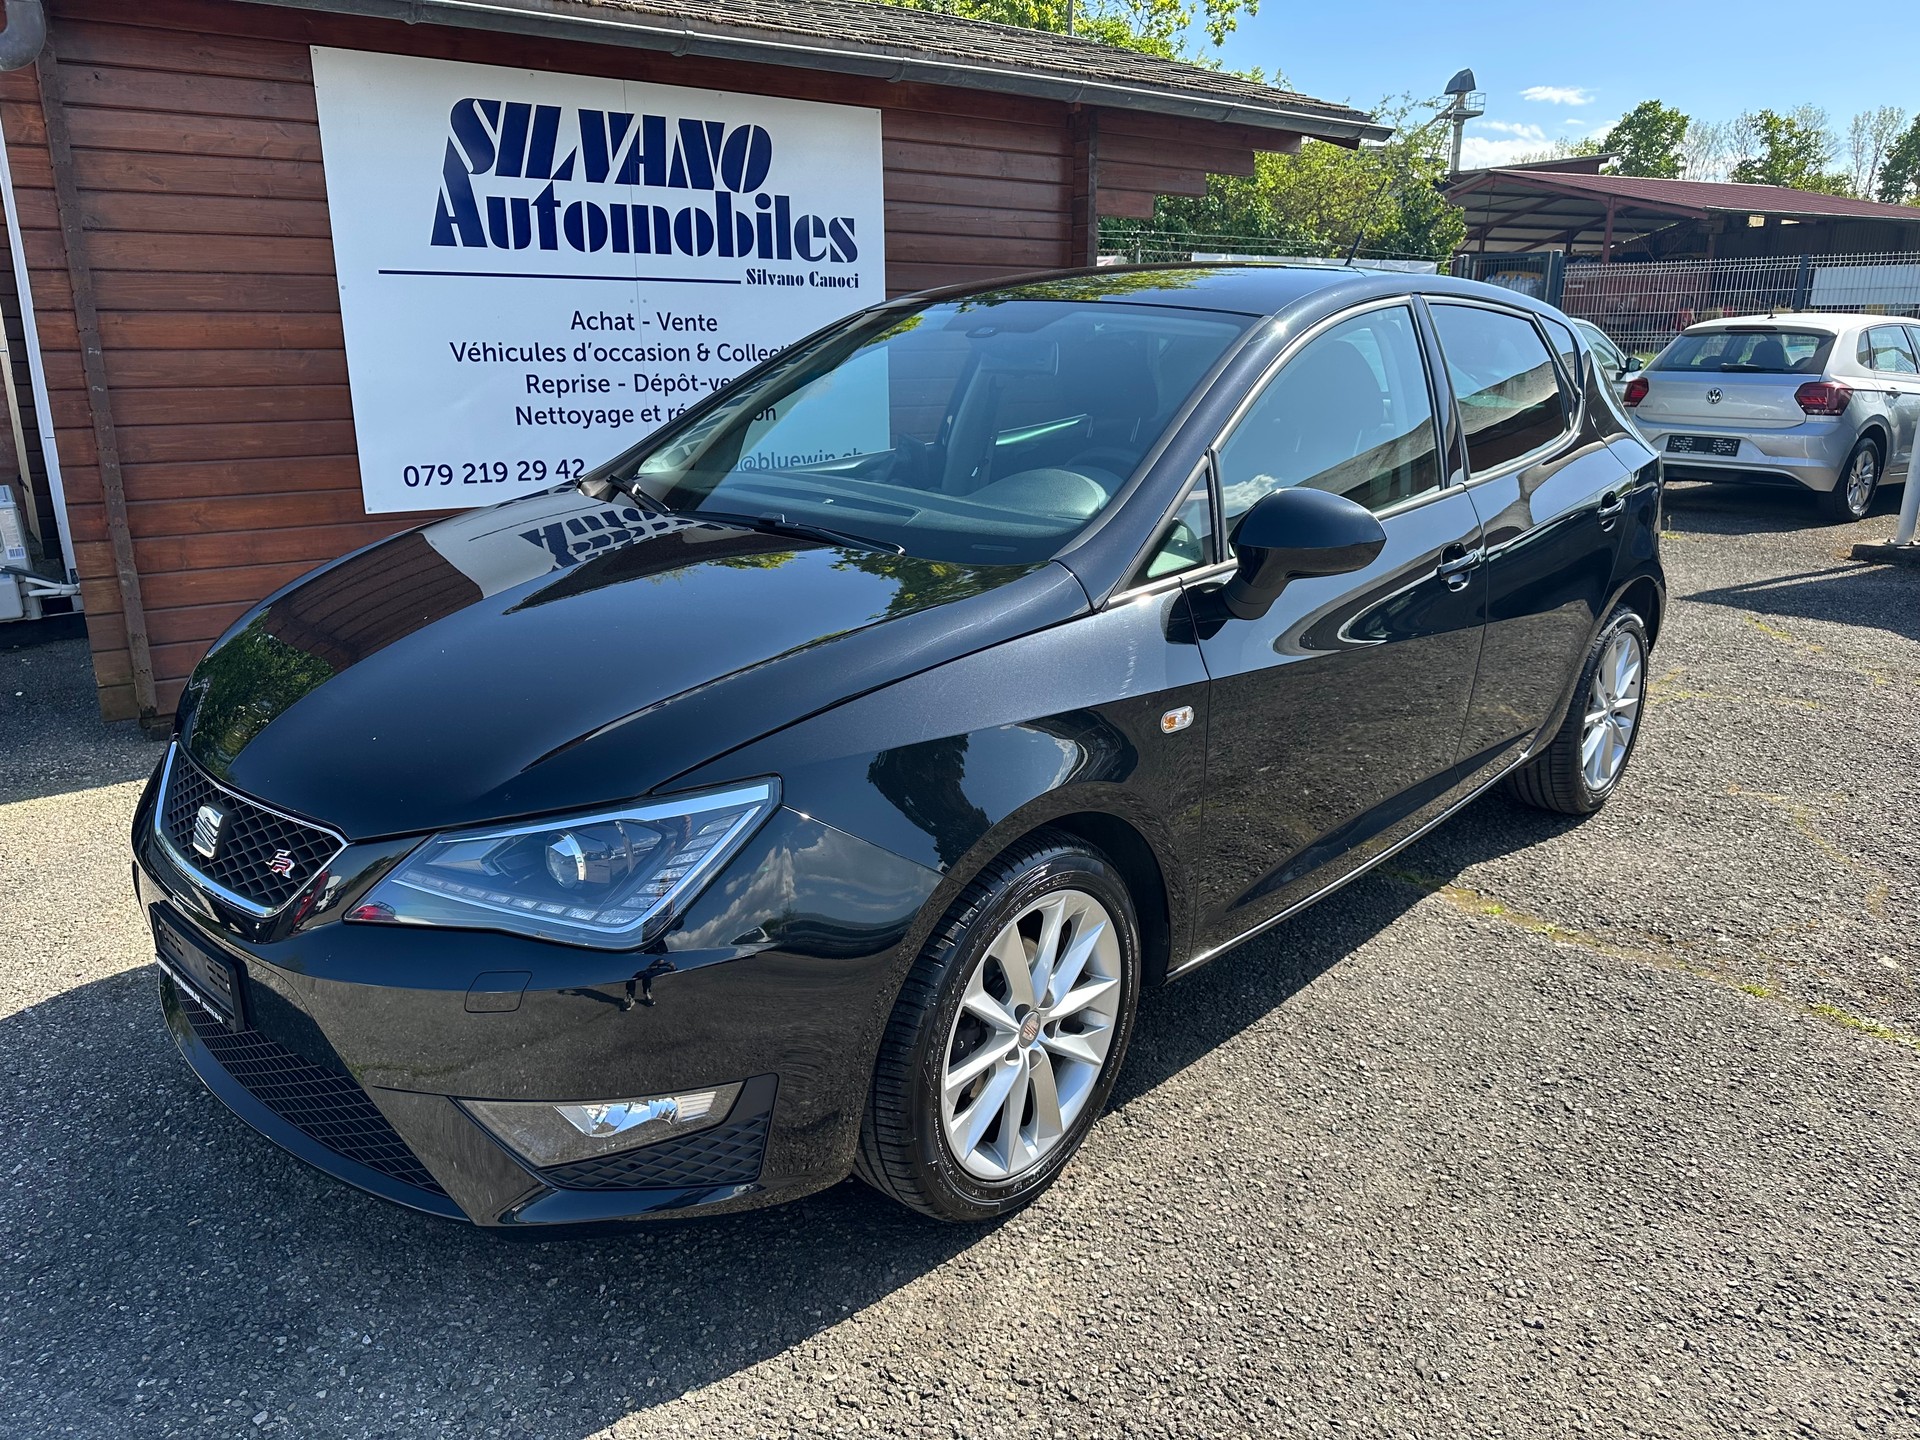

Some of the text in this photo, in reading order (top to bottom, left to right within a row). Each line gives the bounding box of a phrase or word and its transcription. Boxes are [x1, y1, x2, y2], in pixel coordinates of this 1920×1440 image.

[447, 98, 773, 194] SILVANO
[430, 136, 858, 264] Automobiles
[745, 268, 860, 289] Silvano Canoci
[570, 311, 635, 331] Achat
[656, 312, 718, 332] Vente
[449, 341, 567, 363] Véhicules
[696, 343, 711, 362] &
[525, 373, 611, 397] Reprise
[633, 373, 736, 397] Dépôt-ve
[515, 405, 635, 429] Nettoyage
[640, 405, 662, 423] et
[403, 458, 586, 487] 079 219 29 42
